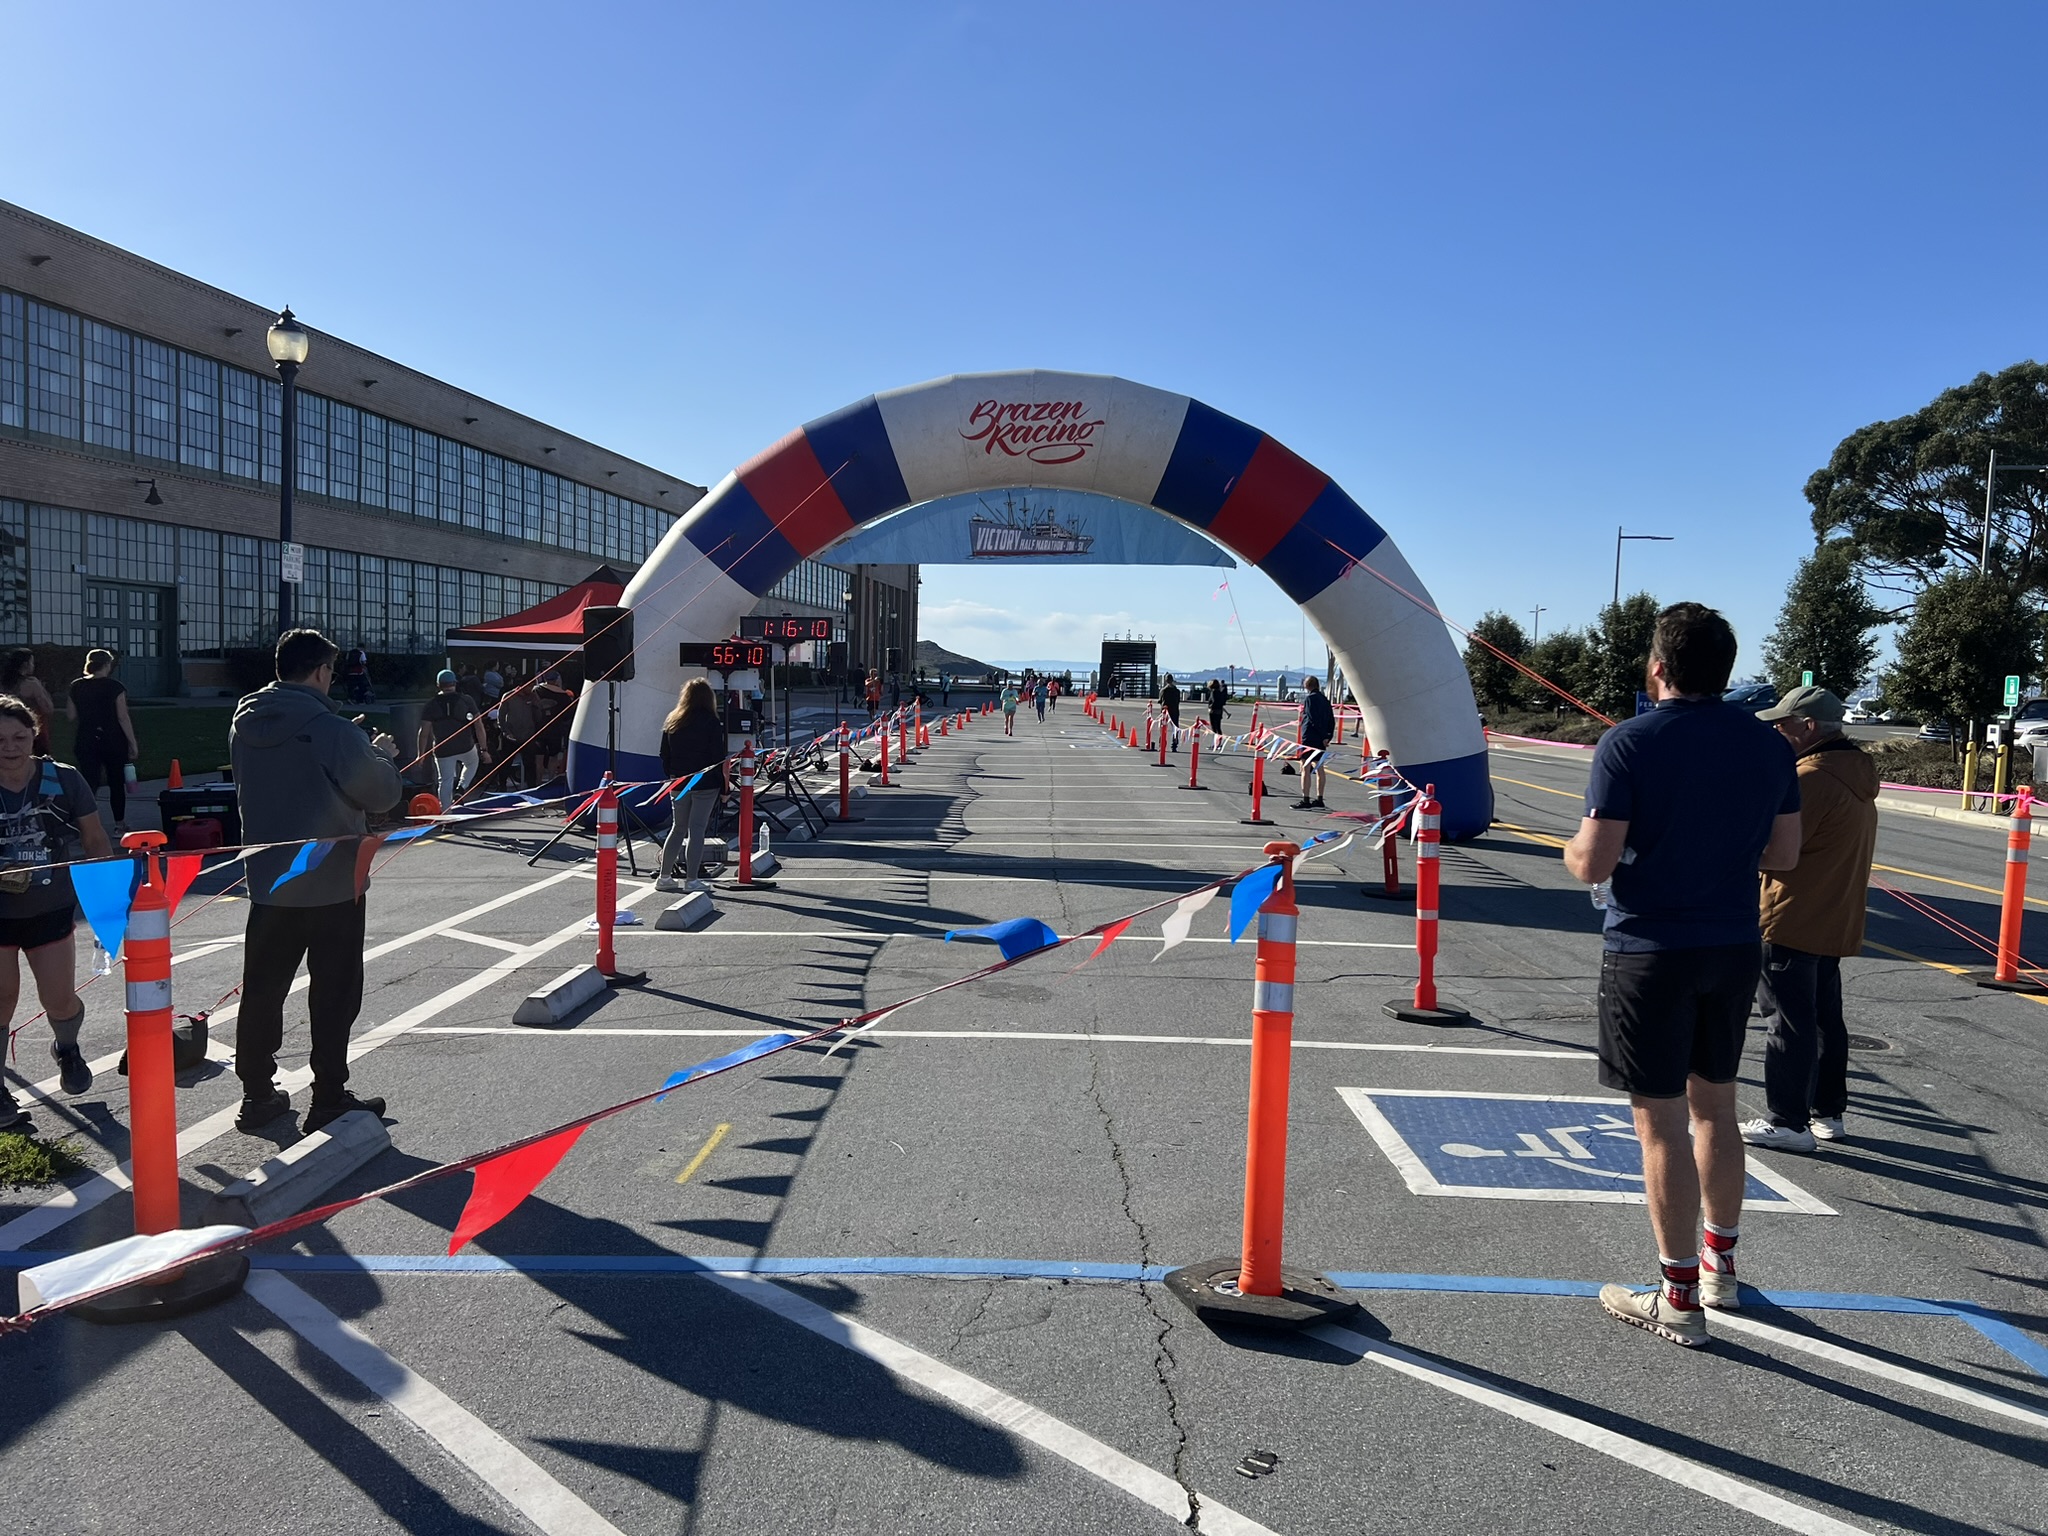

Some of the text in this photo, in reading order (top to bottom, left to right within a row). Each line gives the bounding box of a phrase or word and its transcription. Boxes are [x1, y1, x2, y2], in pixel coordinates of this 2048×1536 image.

[958, 399, 1092, 441] Brazen
[985, 419, 1105, 465] Racing
[976, 527, 1022, 551] VICTORY
[1020, 539, 1035, 551] HALF
[1036, 539, 1064, 551] MARATHON
[283, 543, 288, 553] 2
[1103, 632, 1156, 642] FERRY
[17, 850, 34, 861] 10K
